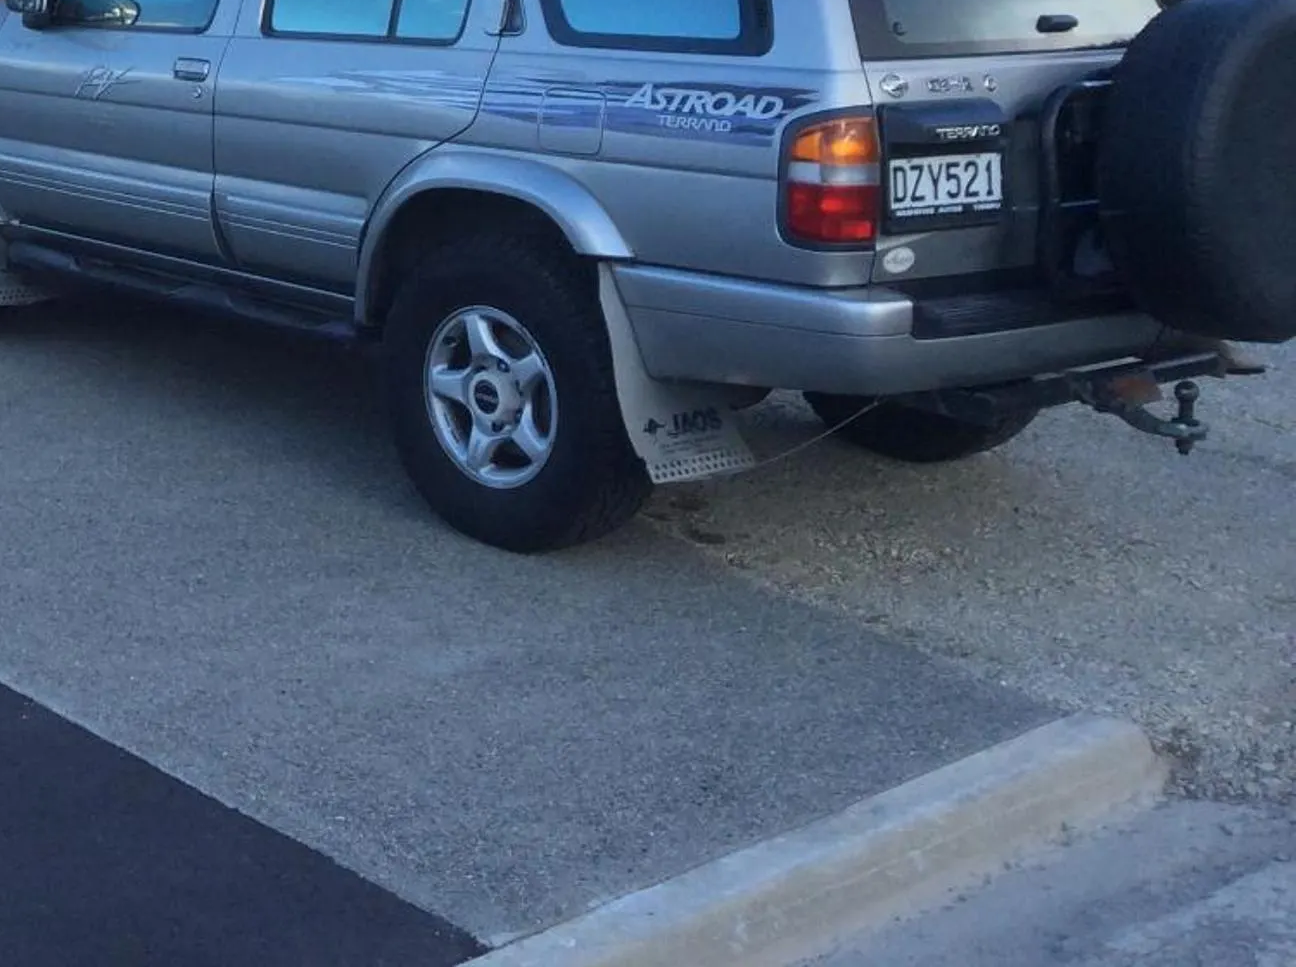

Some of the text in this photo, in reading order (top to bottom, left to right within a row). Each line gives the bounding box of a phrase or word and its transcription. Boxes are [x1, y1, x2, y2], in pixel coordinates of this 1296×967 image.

[624, 82, 784, 119] ASTROAD
[655, 114, 732, 132] TERRANO
[935, 124, 1000, 140] TERRANO
[892, 159, 995, 204] DZY521
